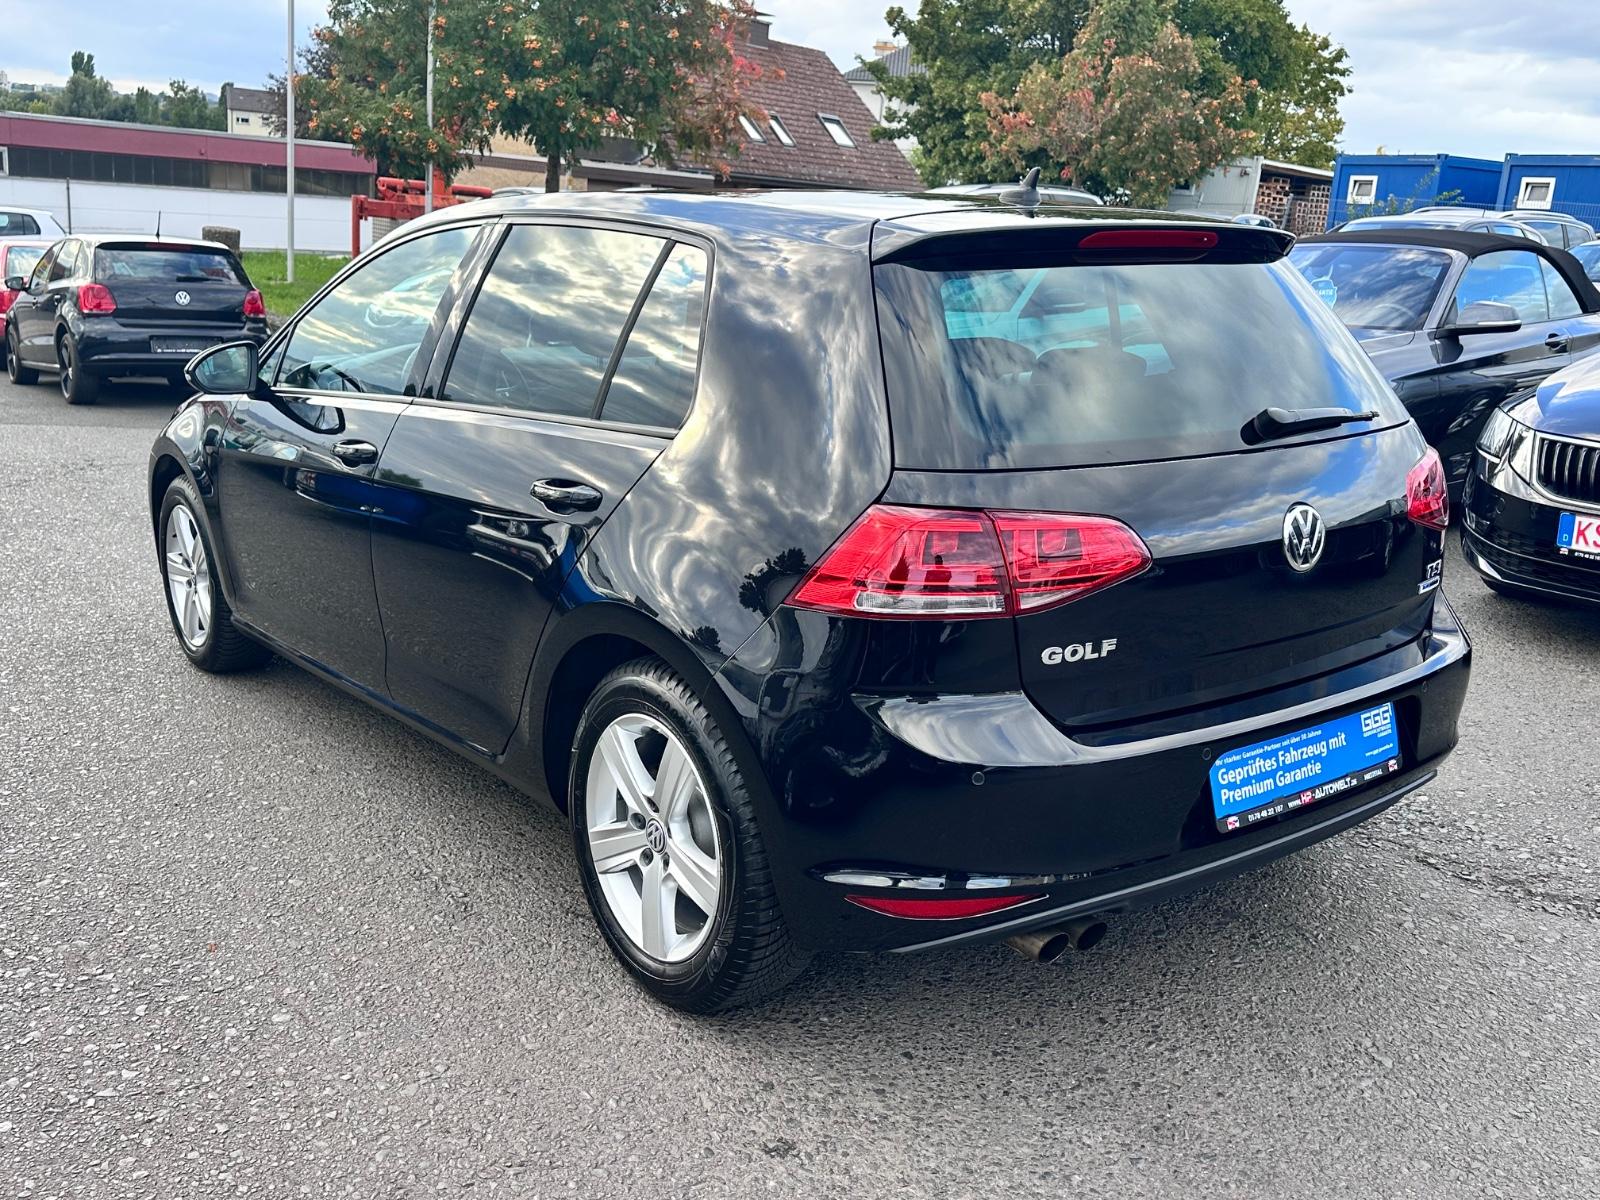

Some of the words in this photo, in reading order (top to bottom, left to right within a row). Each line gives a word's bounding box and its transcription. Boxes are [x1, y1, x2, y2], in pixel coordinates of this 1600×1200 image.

[1562, 533, 1569, 542] D
[1041, 638, 1117, 665] GOLF
[1217, 757, 1278, 785] Geprüftes
[1278, 740, 1328, 767] Fahrzeug
[1328, 731, 1347, 751] mit
[1220, 777, 1275, 806] Premium
[1275, 759, 1322, 787] Garantie
